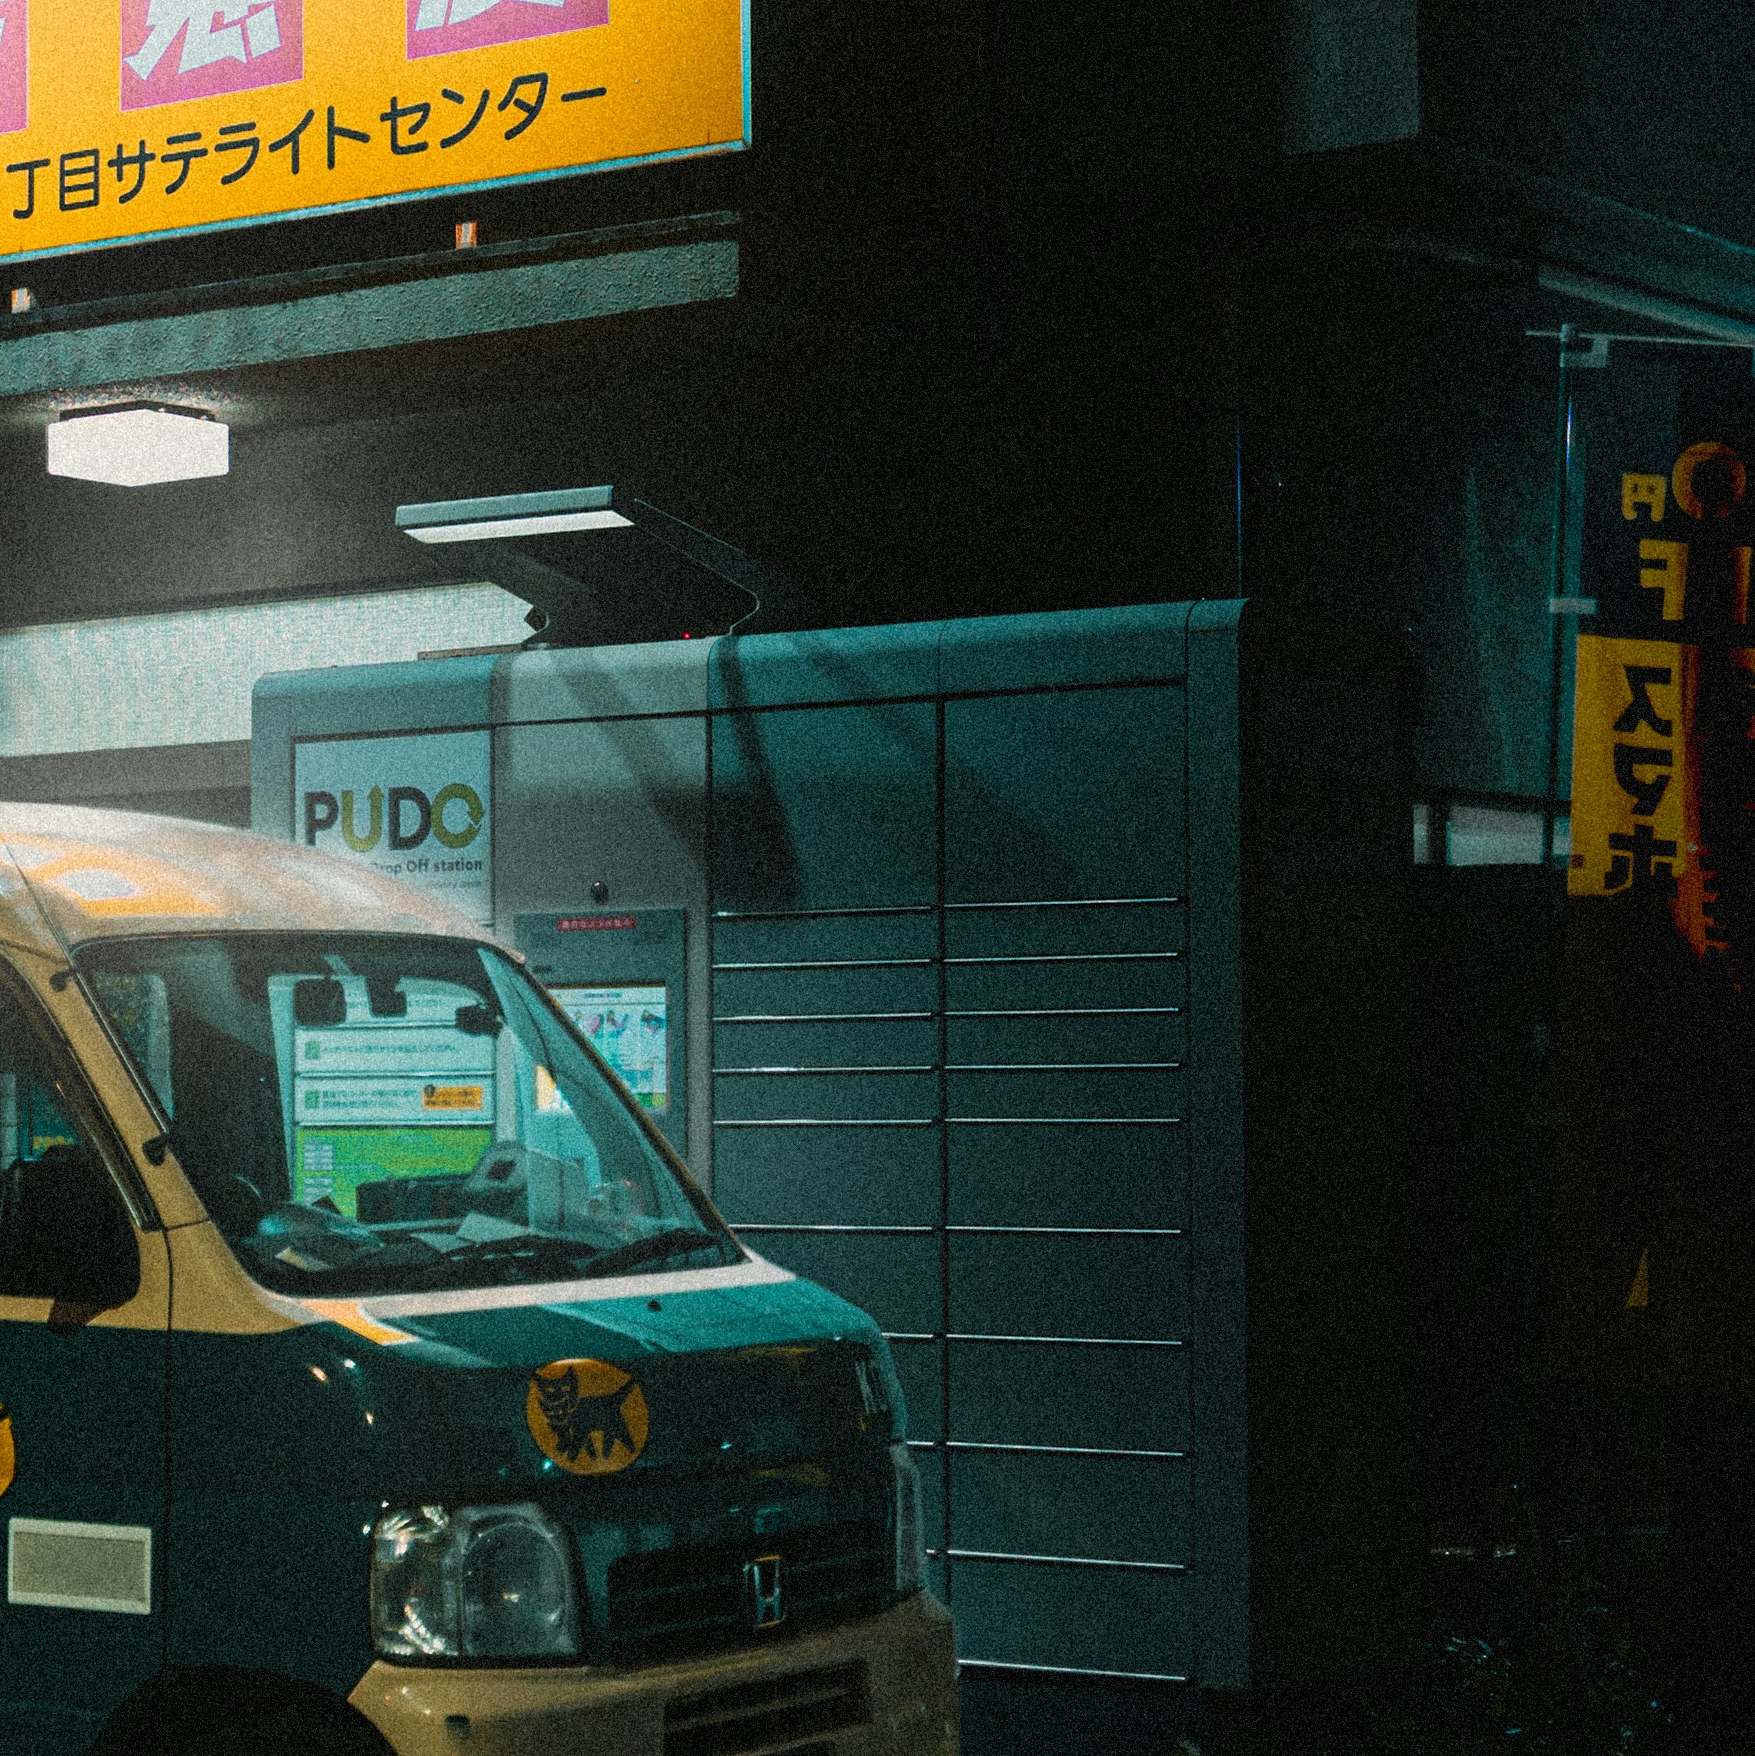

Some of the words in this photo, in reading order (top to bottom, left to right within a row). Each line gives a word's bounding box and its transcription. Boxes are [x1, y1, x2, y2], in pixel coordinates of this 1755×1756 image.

[304, 782, 486, 852] PUDO
[406, 857, 430, 873] Off
[433, 856, 483, 872] station
